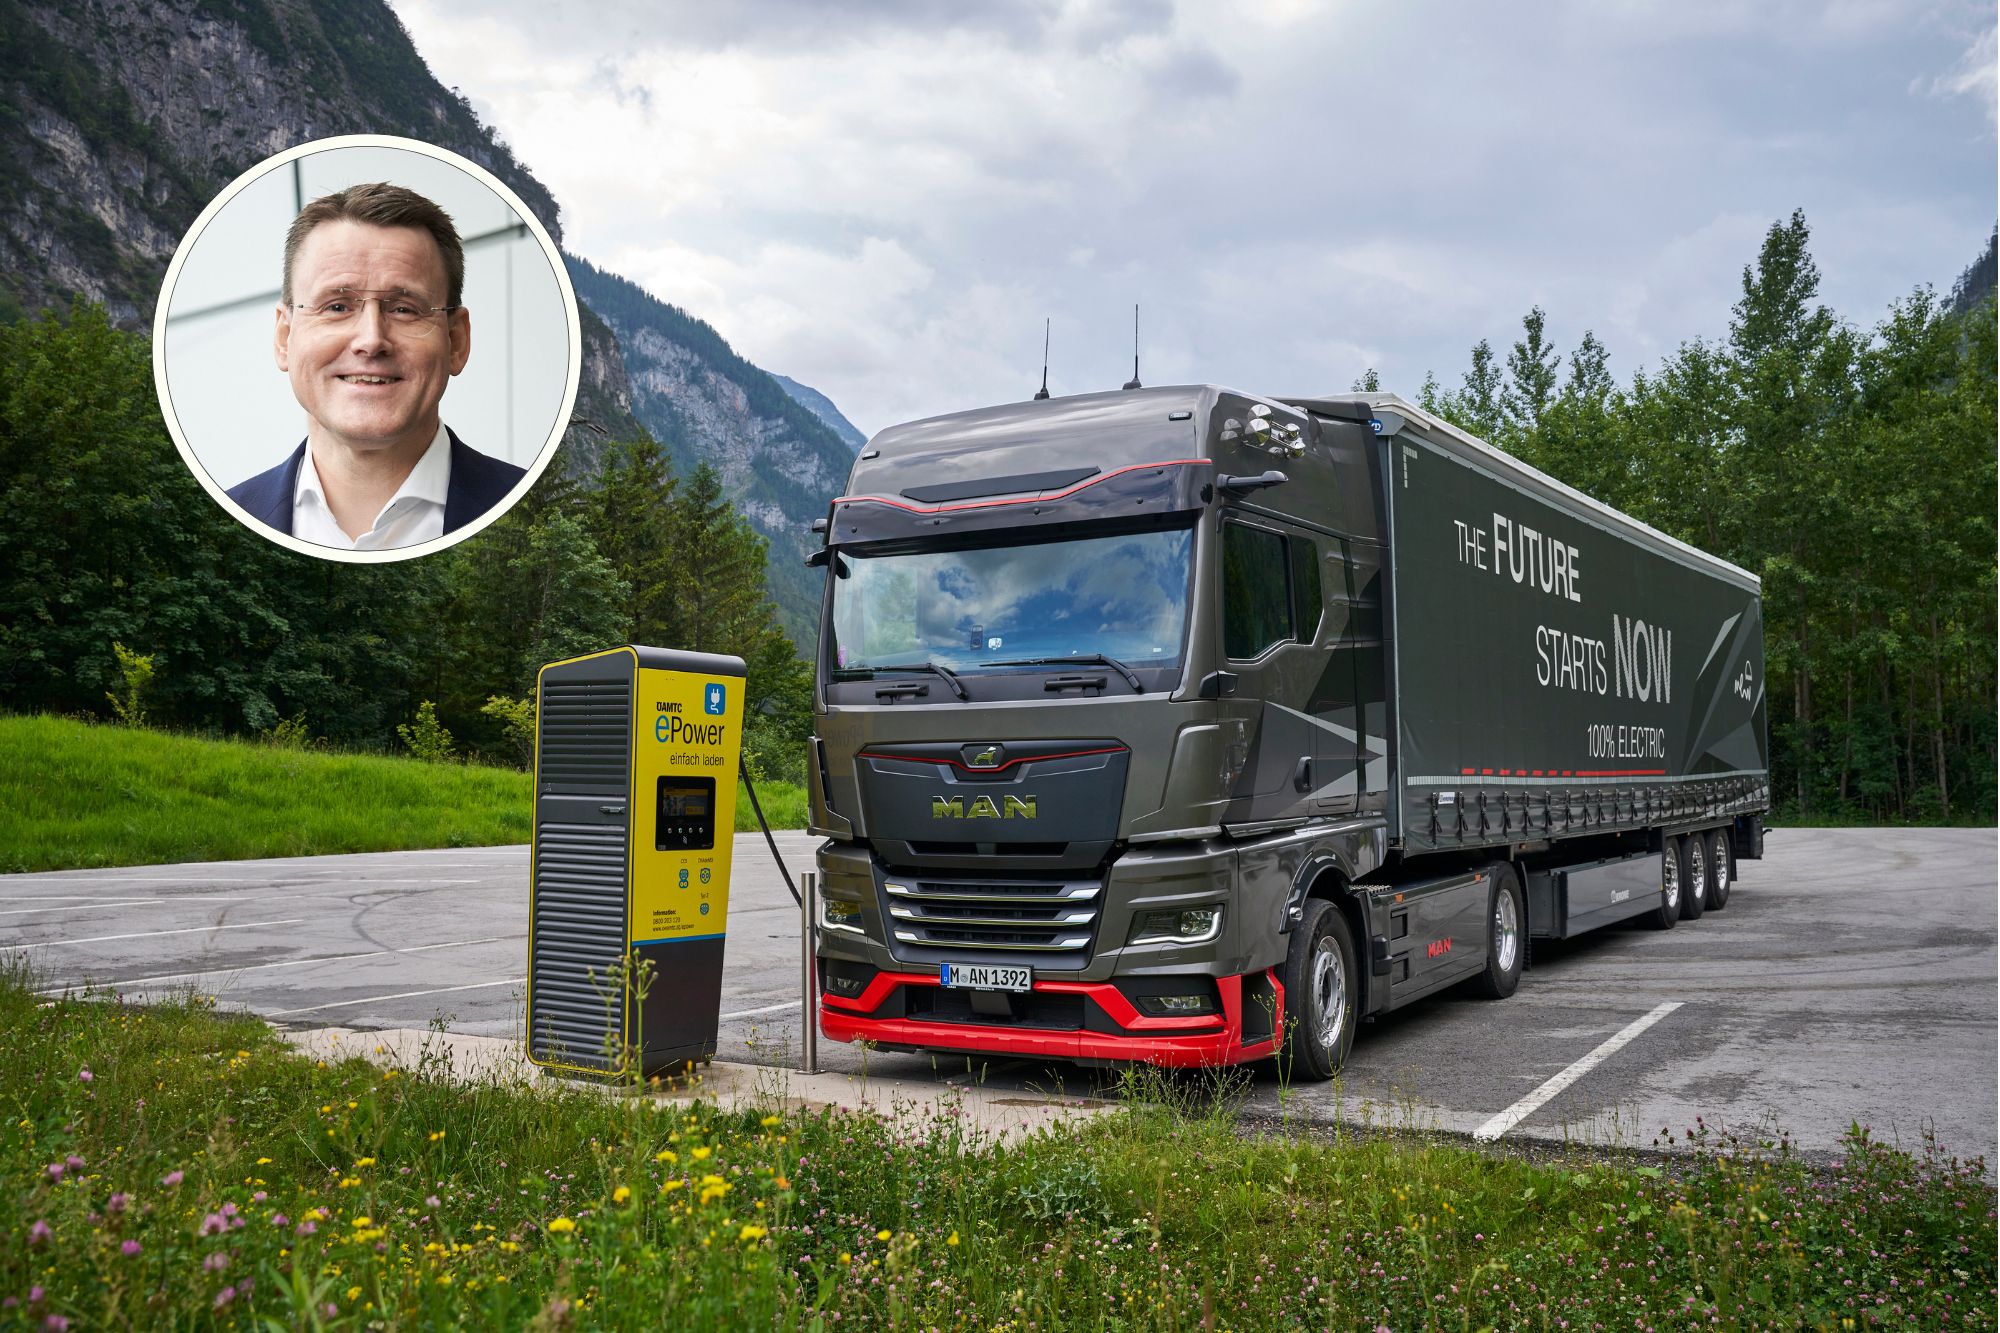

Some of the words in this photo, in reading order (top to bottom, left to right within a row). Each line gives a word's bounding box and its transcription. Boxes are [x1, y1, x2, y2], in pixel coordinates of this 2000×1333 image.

[1454, 519, 1487, 570] THE
[1493, 512, 1581, 603] FUTURE
[1536, 625, 1607, 695] STARTS
[1613, 613, 1672, 704] NOW
[656, 701, 683, 713] ÖAMTC
[655, 714, 725, 745] ePower
[1587, 724, 1615, 758] 100%
[1618, 725, 1665, 758] ELECTRIC
[670, 752, 700, 766] einfach
[702, 753, 725, 766] laden
[932, 795, 1037, 819] MAN
[1427, 936, 1451, 960] MAN
[949, 967, 960, 983] M
[969, 968, 988, 985] AN
[991, 969, 1028, 987] 1392
